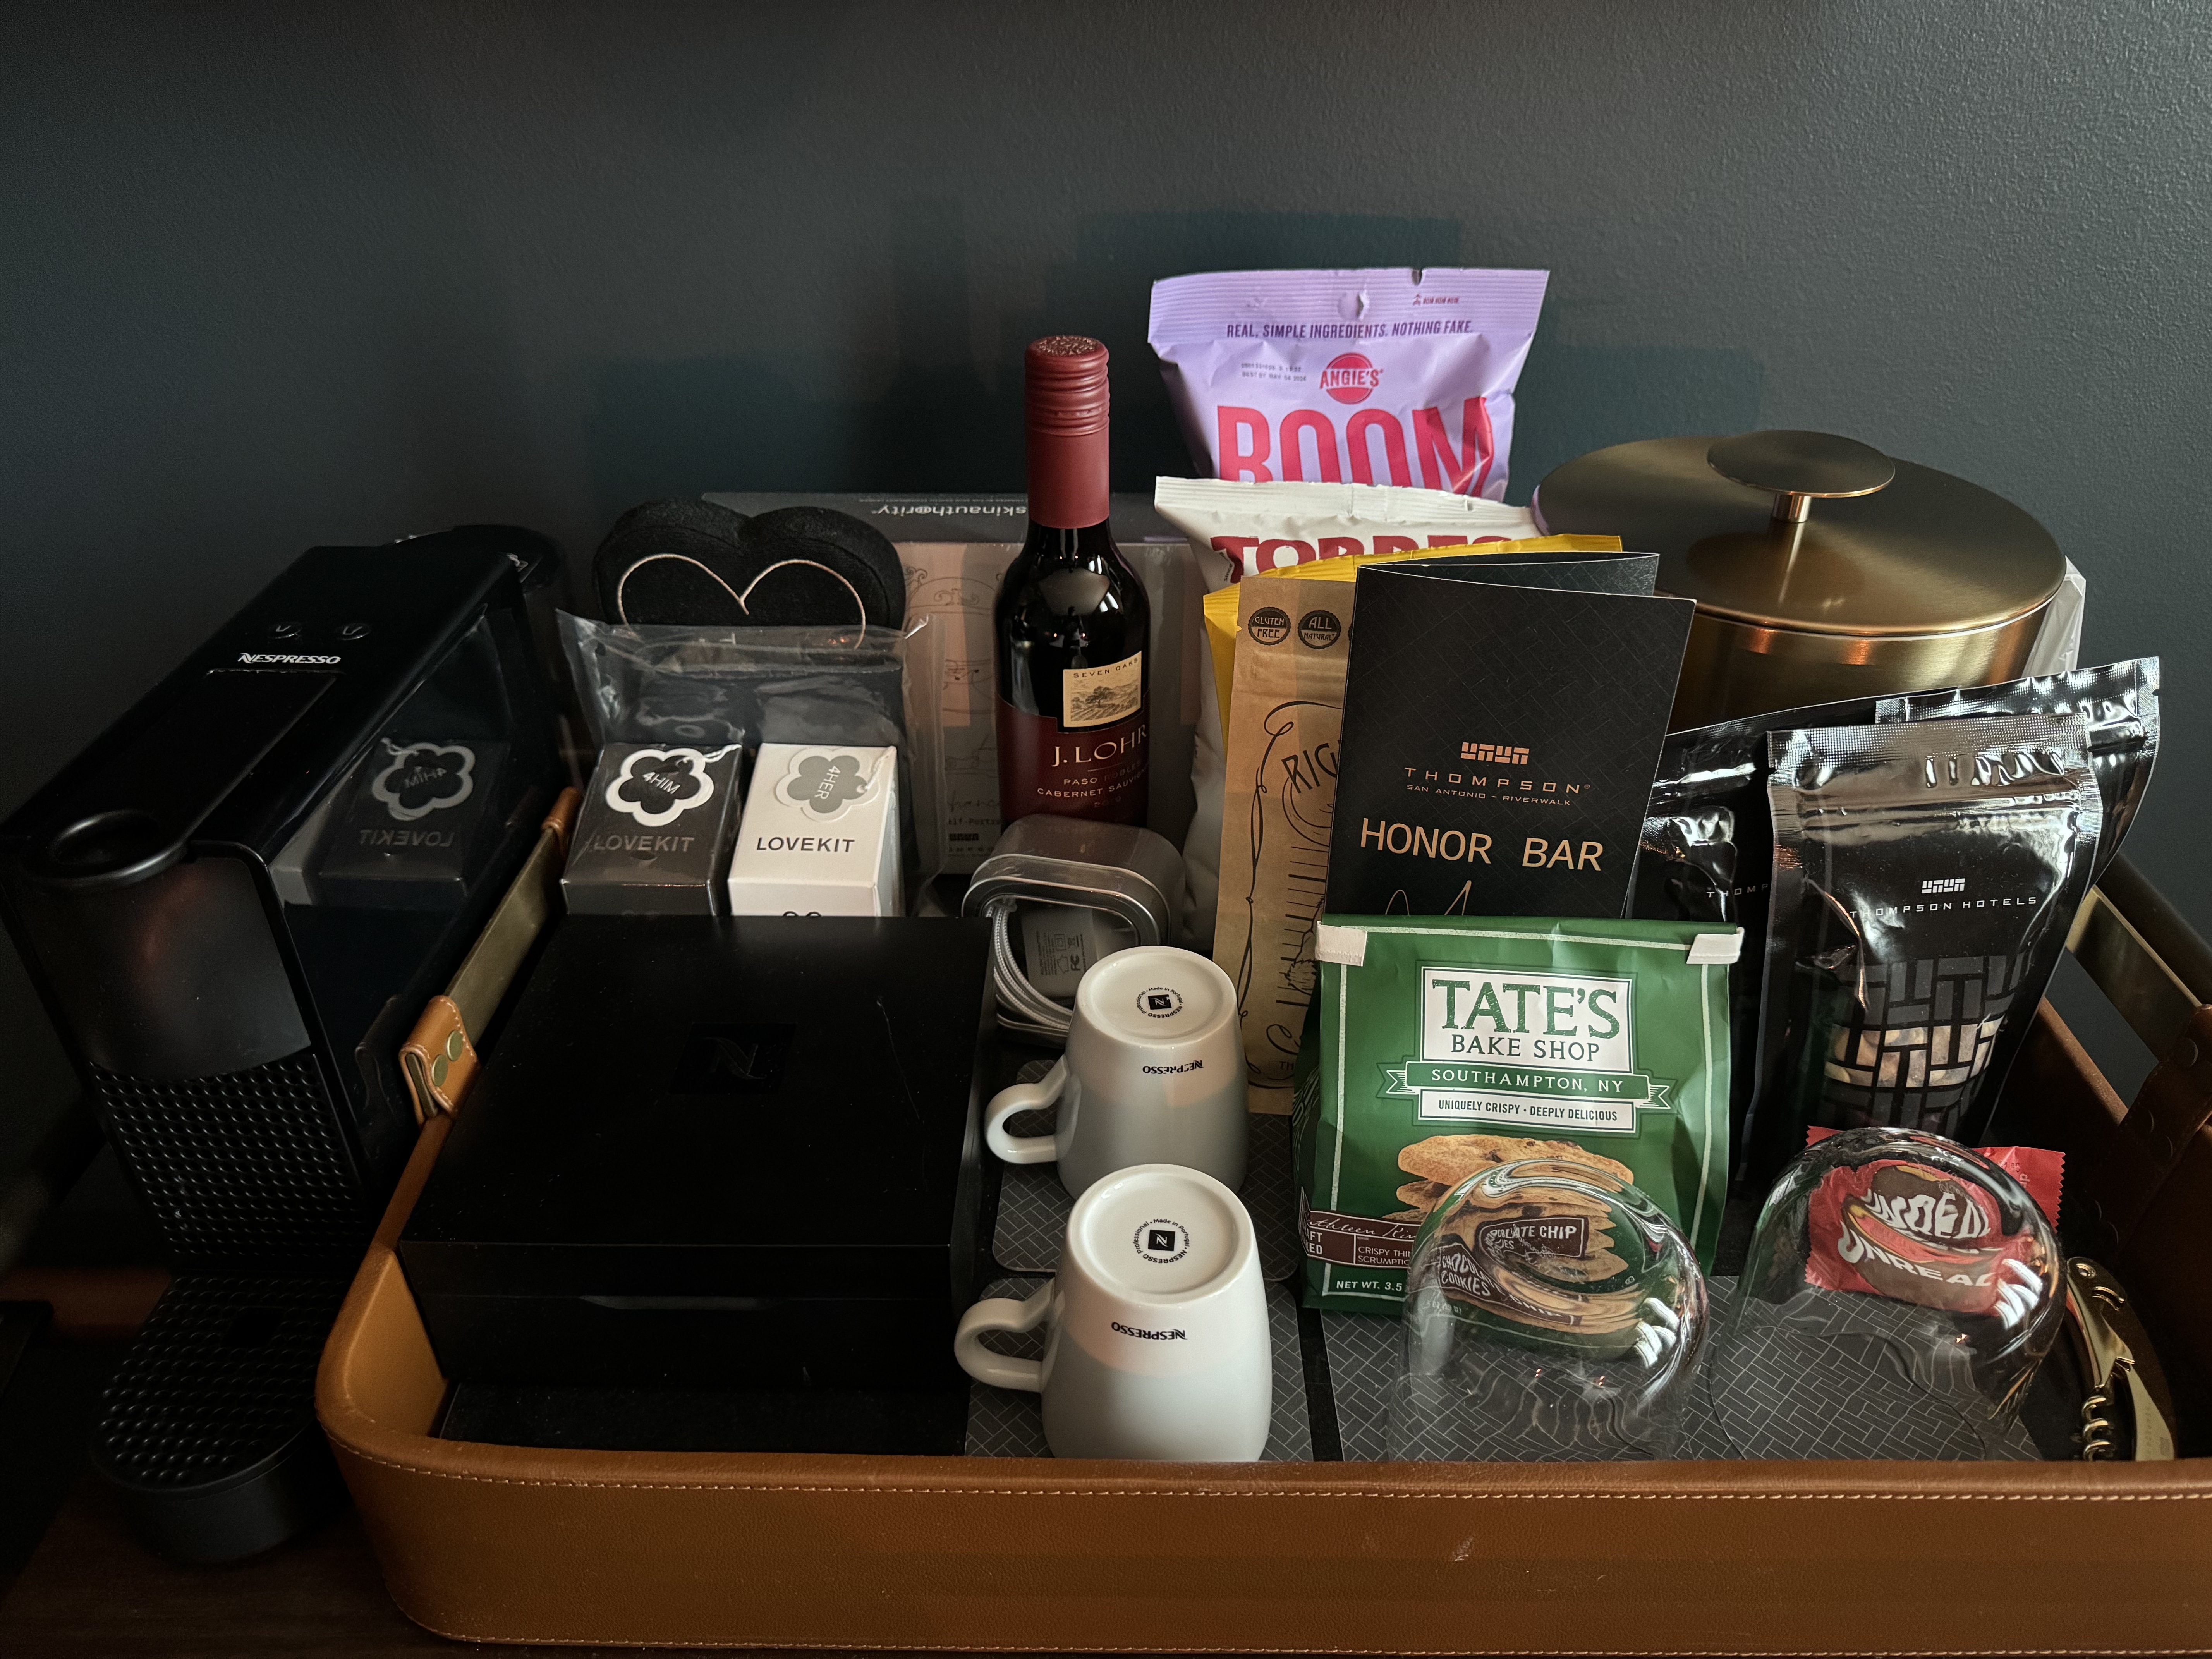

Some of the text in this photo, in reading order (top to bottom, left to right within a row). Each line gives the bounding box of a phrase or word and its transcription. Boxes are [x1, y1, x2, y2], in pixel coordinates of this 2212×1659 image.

[1263, 324, 1306, 338] SIMPLE
[1309, 323, 1388, 338] INGREDIENTS.
[1392, 321, 1441, 337] NOTHING
[1319, 369, 1379, 389] ANGIE'S
[1218, 397, 1494, 498] BOOM
[1255, 617, 1284, 625] GLUTEN
[1308, 617, 1332, 630] ALL
[1257, 628, 1280, 638] FREE
[237, 652, 341, 665] NESPRESSO
[1073, 658, 1138, 678] SEVEN OAKS
[642, 771, 681, 795] 4HIM
[814, 765, 842, 800] 4HER
[1064, 777, 1098, 785] PASO
[1404, 767, 1579, 794] THOMPSON
[1037, 788, 1103, 798] CABERNET
[1435, 788, 1486, 799] ANTONIO
[1502, 795, 1571, 805] RIVERWALK
[594, 835, 695, 852] LOVEKIT
[756, 837, 855, 852] LOVEKIT
[1360, 817, 1603, 871] HONOR BAR
[1849, 896, 2038, 919] THOMPSON HOTELS
[1432, 979, 1621, 1039] TATE'S
[1450, 1034, 1600, 1061] BAKE SHOP
[1142, 1060, 1204, 1074] NESPRESSO
[1431, 1068, 1623, 1092] SOUTHAMPTON, NY
[1438, 1099, 1618, 1121] UNIQUELY CRISPY DEEPLY DELICIOUS
[1539, 1225, 1578, 1240] CHIP
[1142, 1249, 1187, 1264] NESPRESSO
[1358, 1246, 1390, 1257] CRISPY
[1336, 1280, 1403, 1291] NET WT. 3.5
[1111, 1322, 1188, 1340] NESPRESSO
